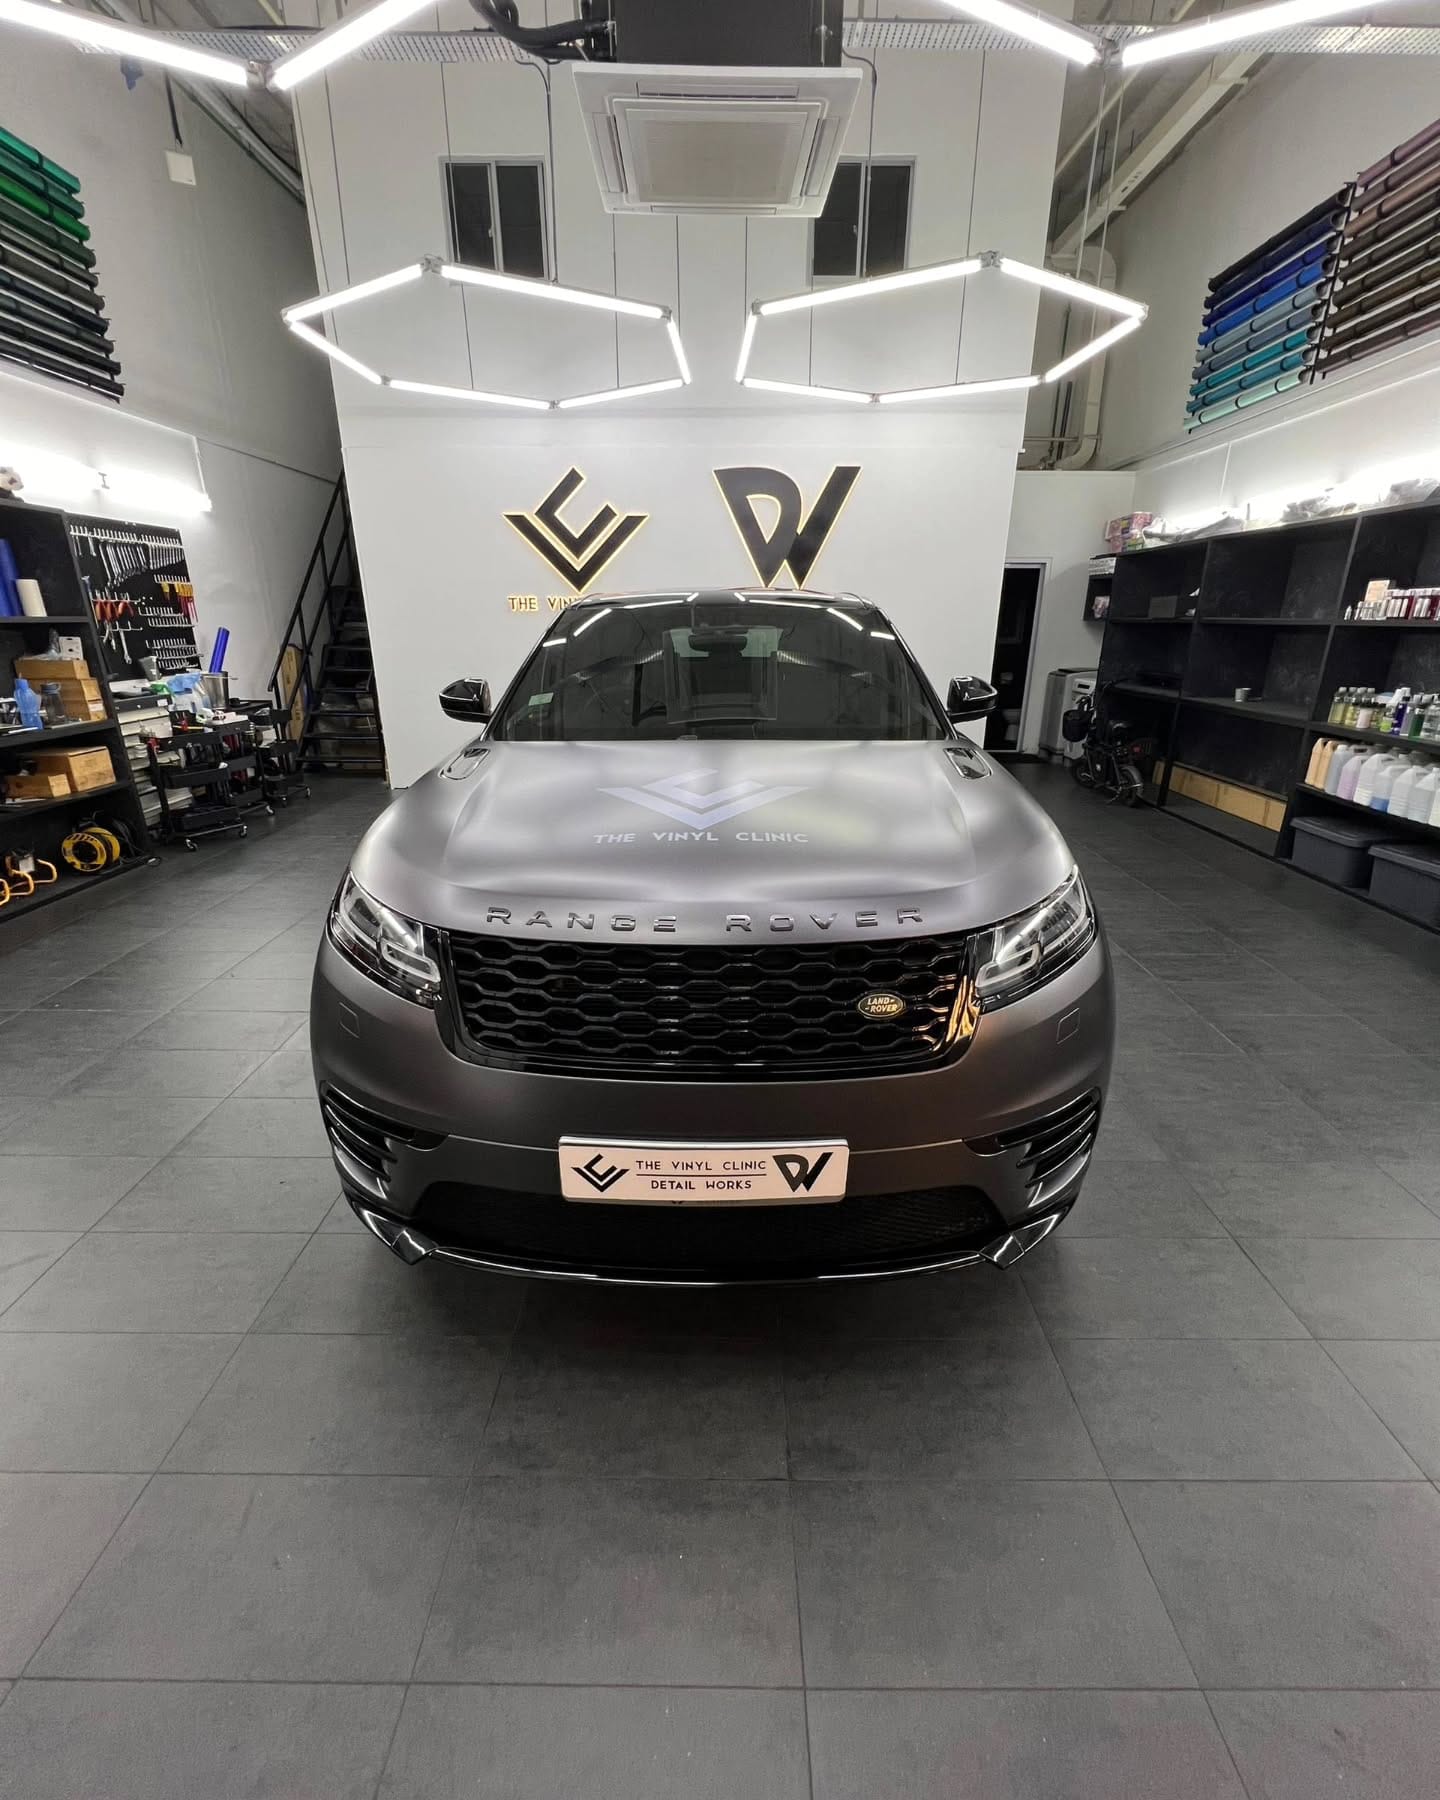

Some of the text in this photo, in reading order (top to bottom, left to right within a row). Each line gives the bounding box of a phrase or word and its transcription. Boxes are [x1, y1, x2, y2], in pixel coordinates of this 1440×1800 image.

[507, 596, 538, 610] THE
[593, 831, 810, 844] THE VINYL CLINIC
[486, 906, 924, 932] RANGE ROVER
[635, 1160, 767, 1171] THE VINYL CLINIC
[650, 1179, 752, 1190] DETAIL WORKS
